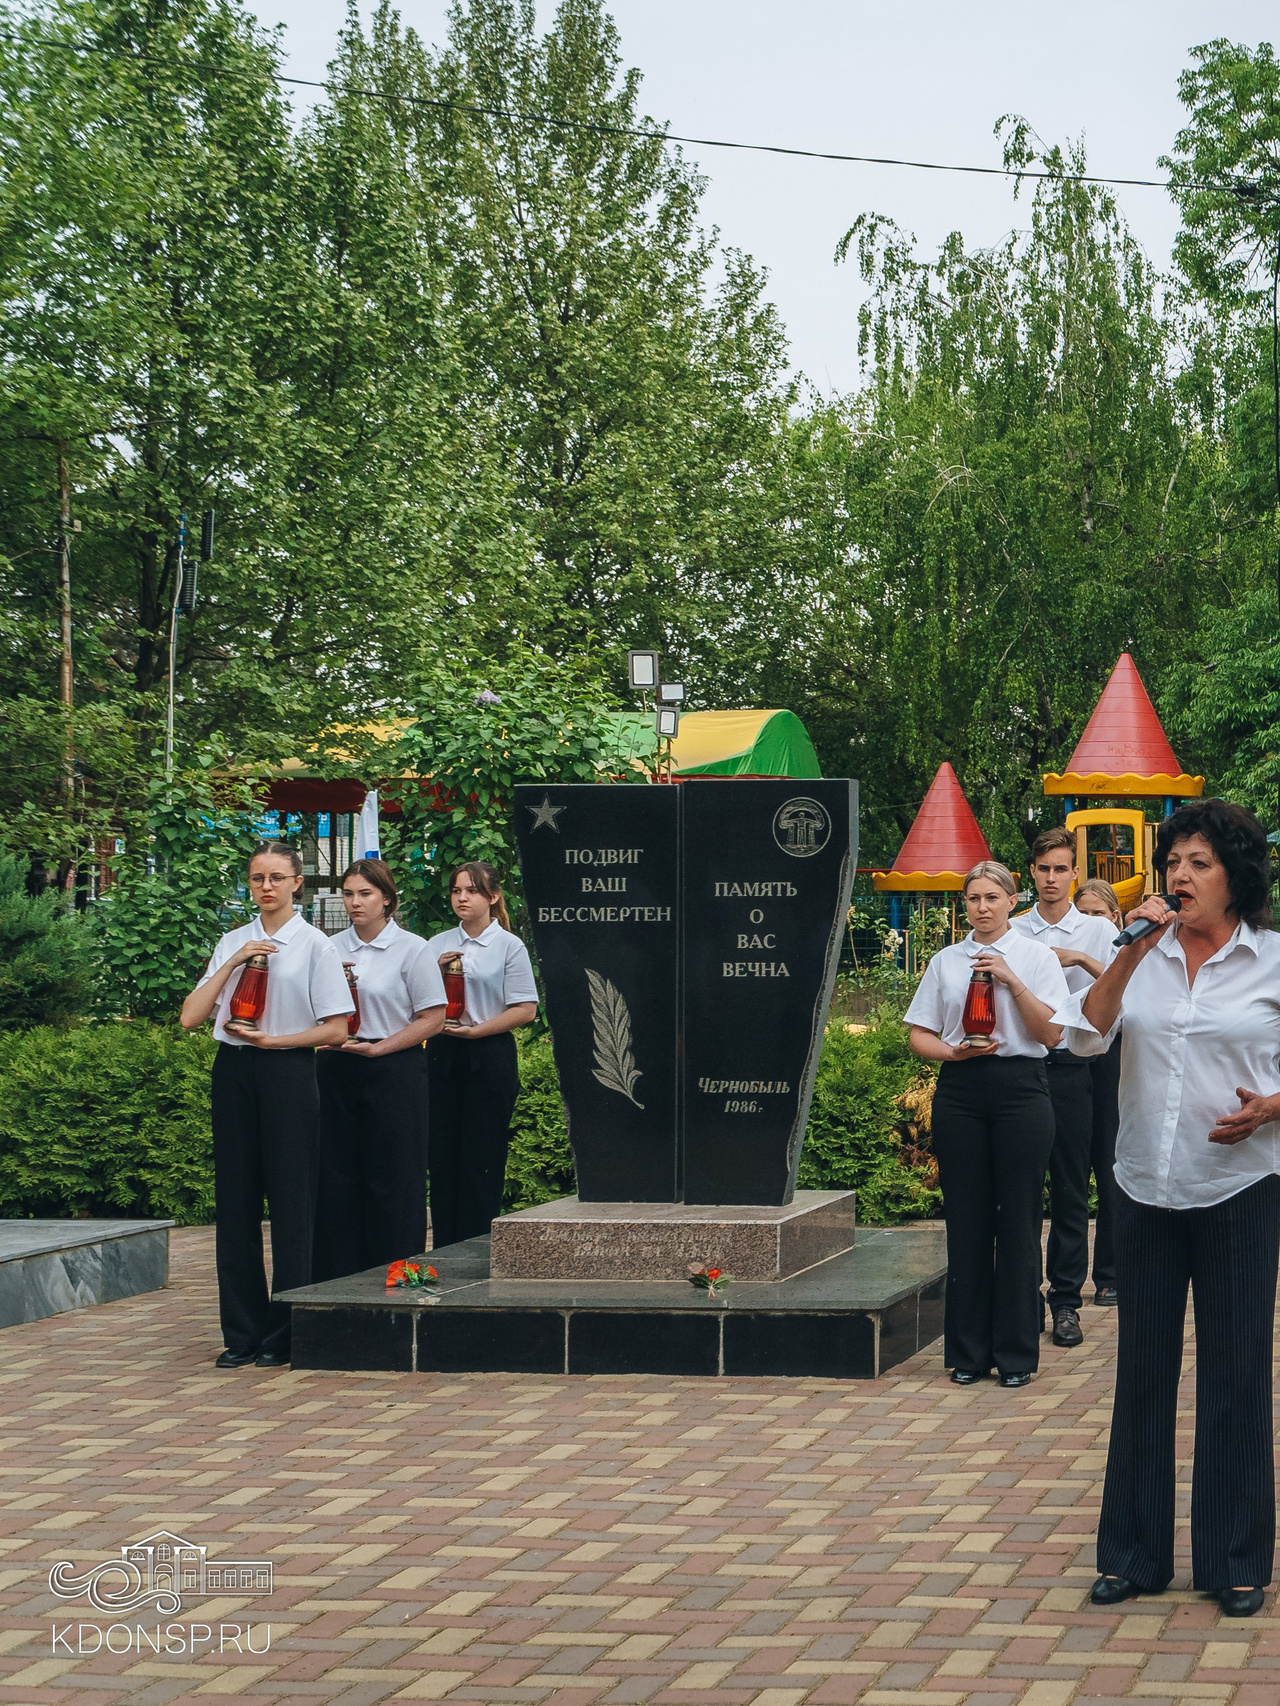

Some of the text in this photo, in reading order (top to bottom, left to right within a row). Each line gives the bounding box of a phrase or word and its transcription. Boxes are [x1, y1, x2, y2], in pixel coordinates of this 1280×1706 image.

[565, 849, 643, 867] ПОДВИГ
[581, 878, 627, 893] ВАШ
[714, 882, 798, 897] ПАМЯТЬ
[538, 906, 671, 922] БЕССМЕРТЕН
[750, 909, 764, 924] О
[737, 934, 776, 949] ВАС
[722, 962, 790, 977] ВЕЧНА
[698, 1077, 791, 1094] ЧЕРНОБЫЛЬ
